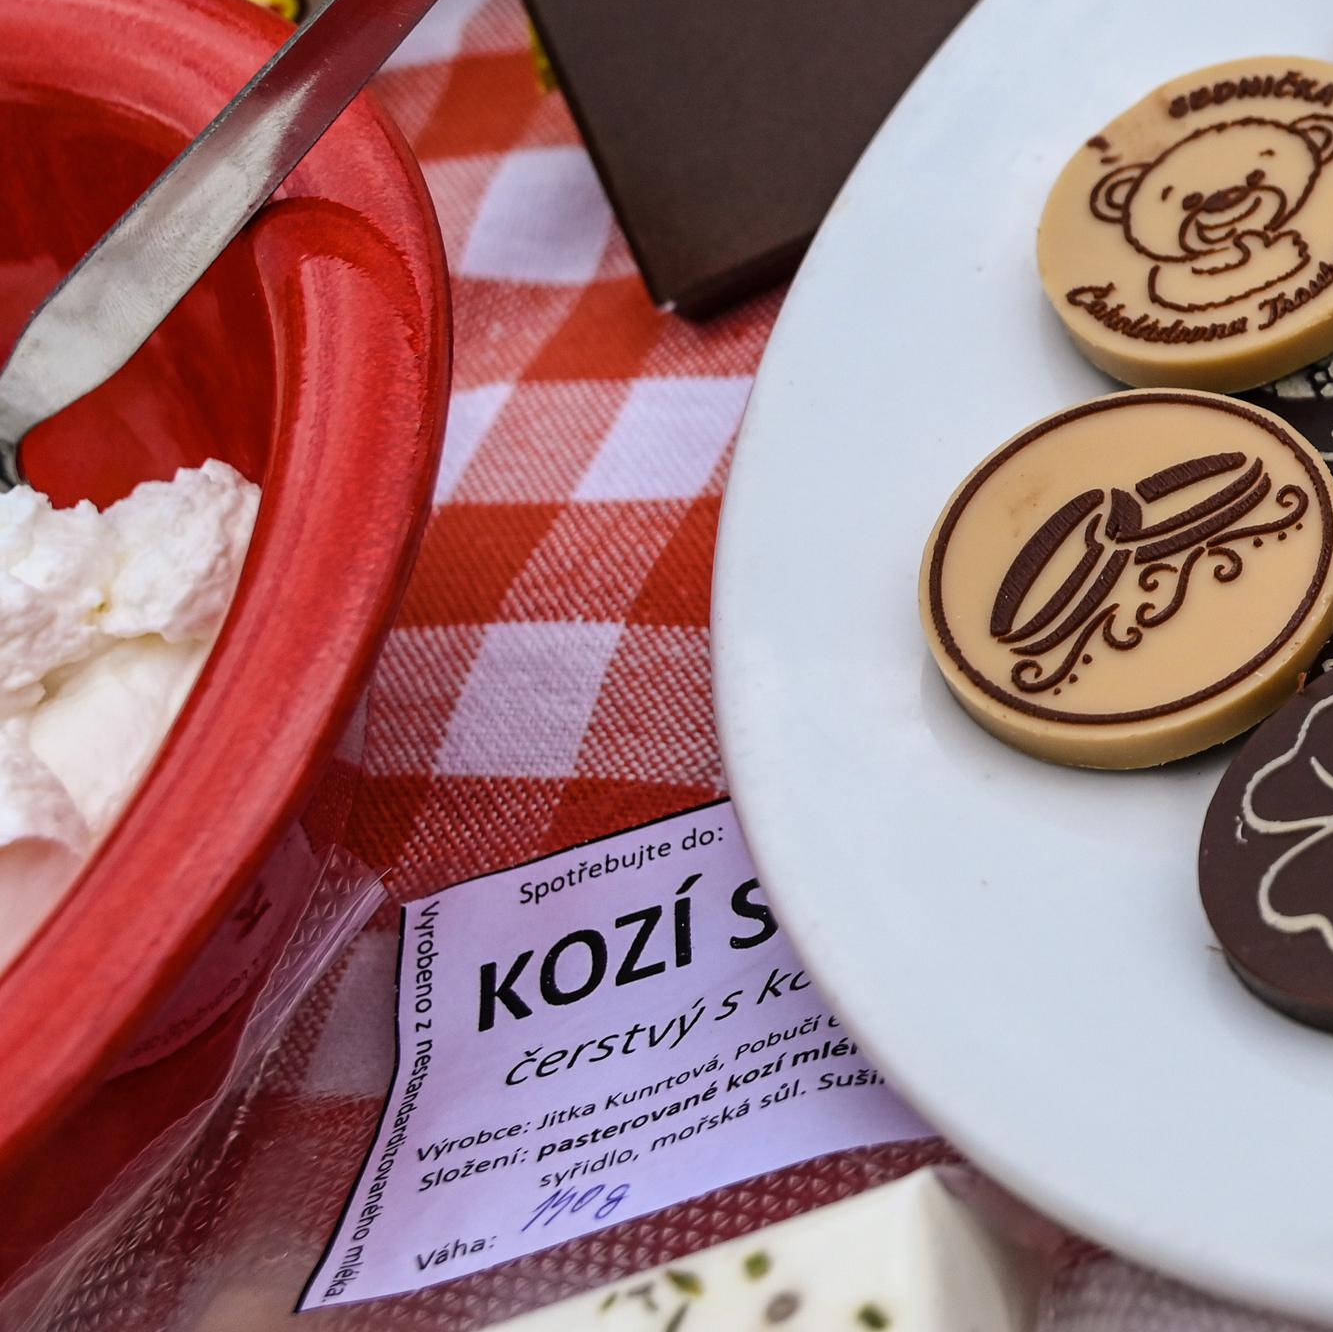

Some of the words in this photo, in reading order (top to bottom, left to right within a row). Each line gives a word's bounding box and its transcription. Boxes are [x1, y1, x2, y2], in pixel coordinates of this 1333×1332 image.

[519, 842, 672, 905] Spotřebujte
[681, 826, 725, 852] do:
[414, 900, 440, 1015] Vyrobeno
[477, 873, 703, 1033] KOZÍ
[729, 877, 780, 950] S
[415, 1019, 433, 1033] z
[504, 996, 706, 1086] čerstvý
[714, 989, 744, 1021] s
[416, 1120, 532, 1163] Výrobce:
[537, 1101, 597, 1131] Jitka
[604, 1054, 725, 1111] Kunrtová,
[734, 1014, 823, 1061] Pobučí
[417, 1147, 530, 1193] Složení:
[536, 1082, 718, 1163] pasterované
[726, 1052, 788, 1093] kozí
[791, 1037, 859, 1068] mlé
[538, 1148, 641, 1189] syřidlo,
[650, 1098, 751, 1152] mořská
[760, 1078, 807, 1110] sůl.
[416, 1235, 498, 1271] Váha:
